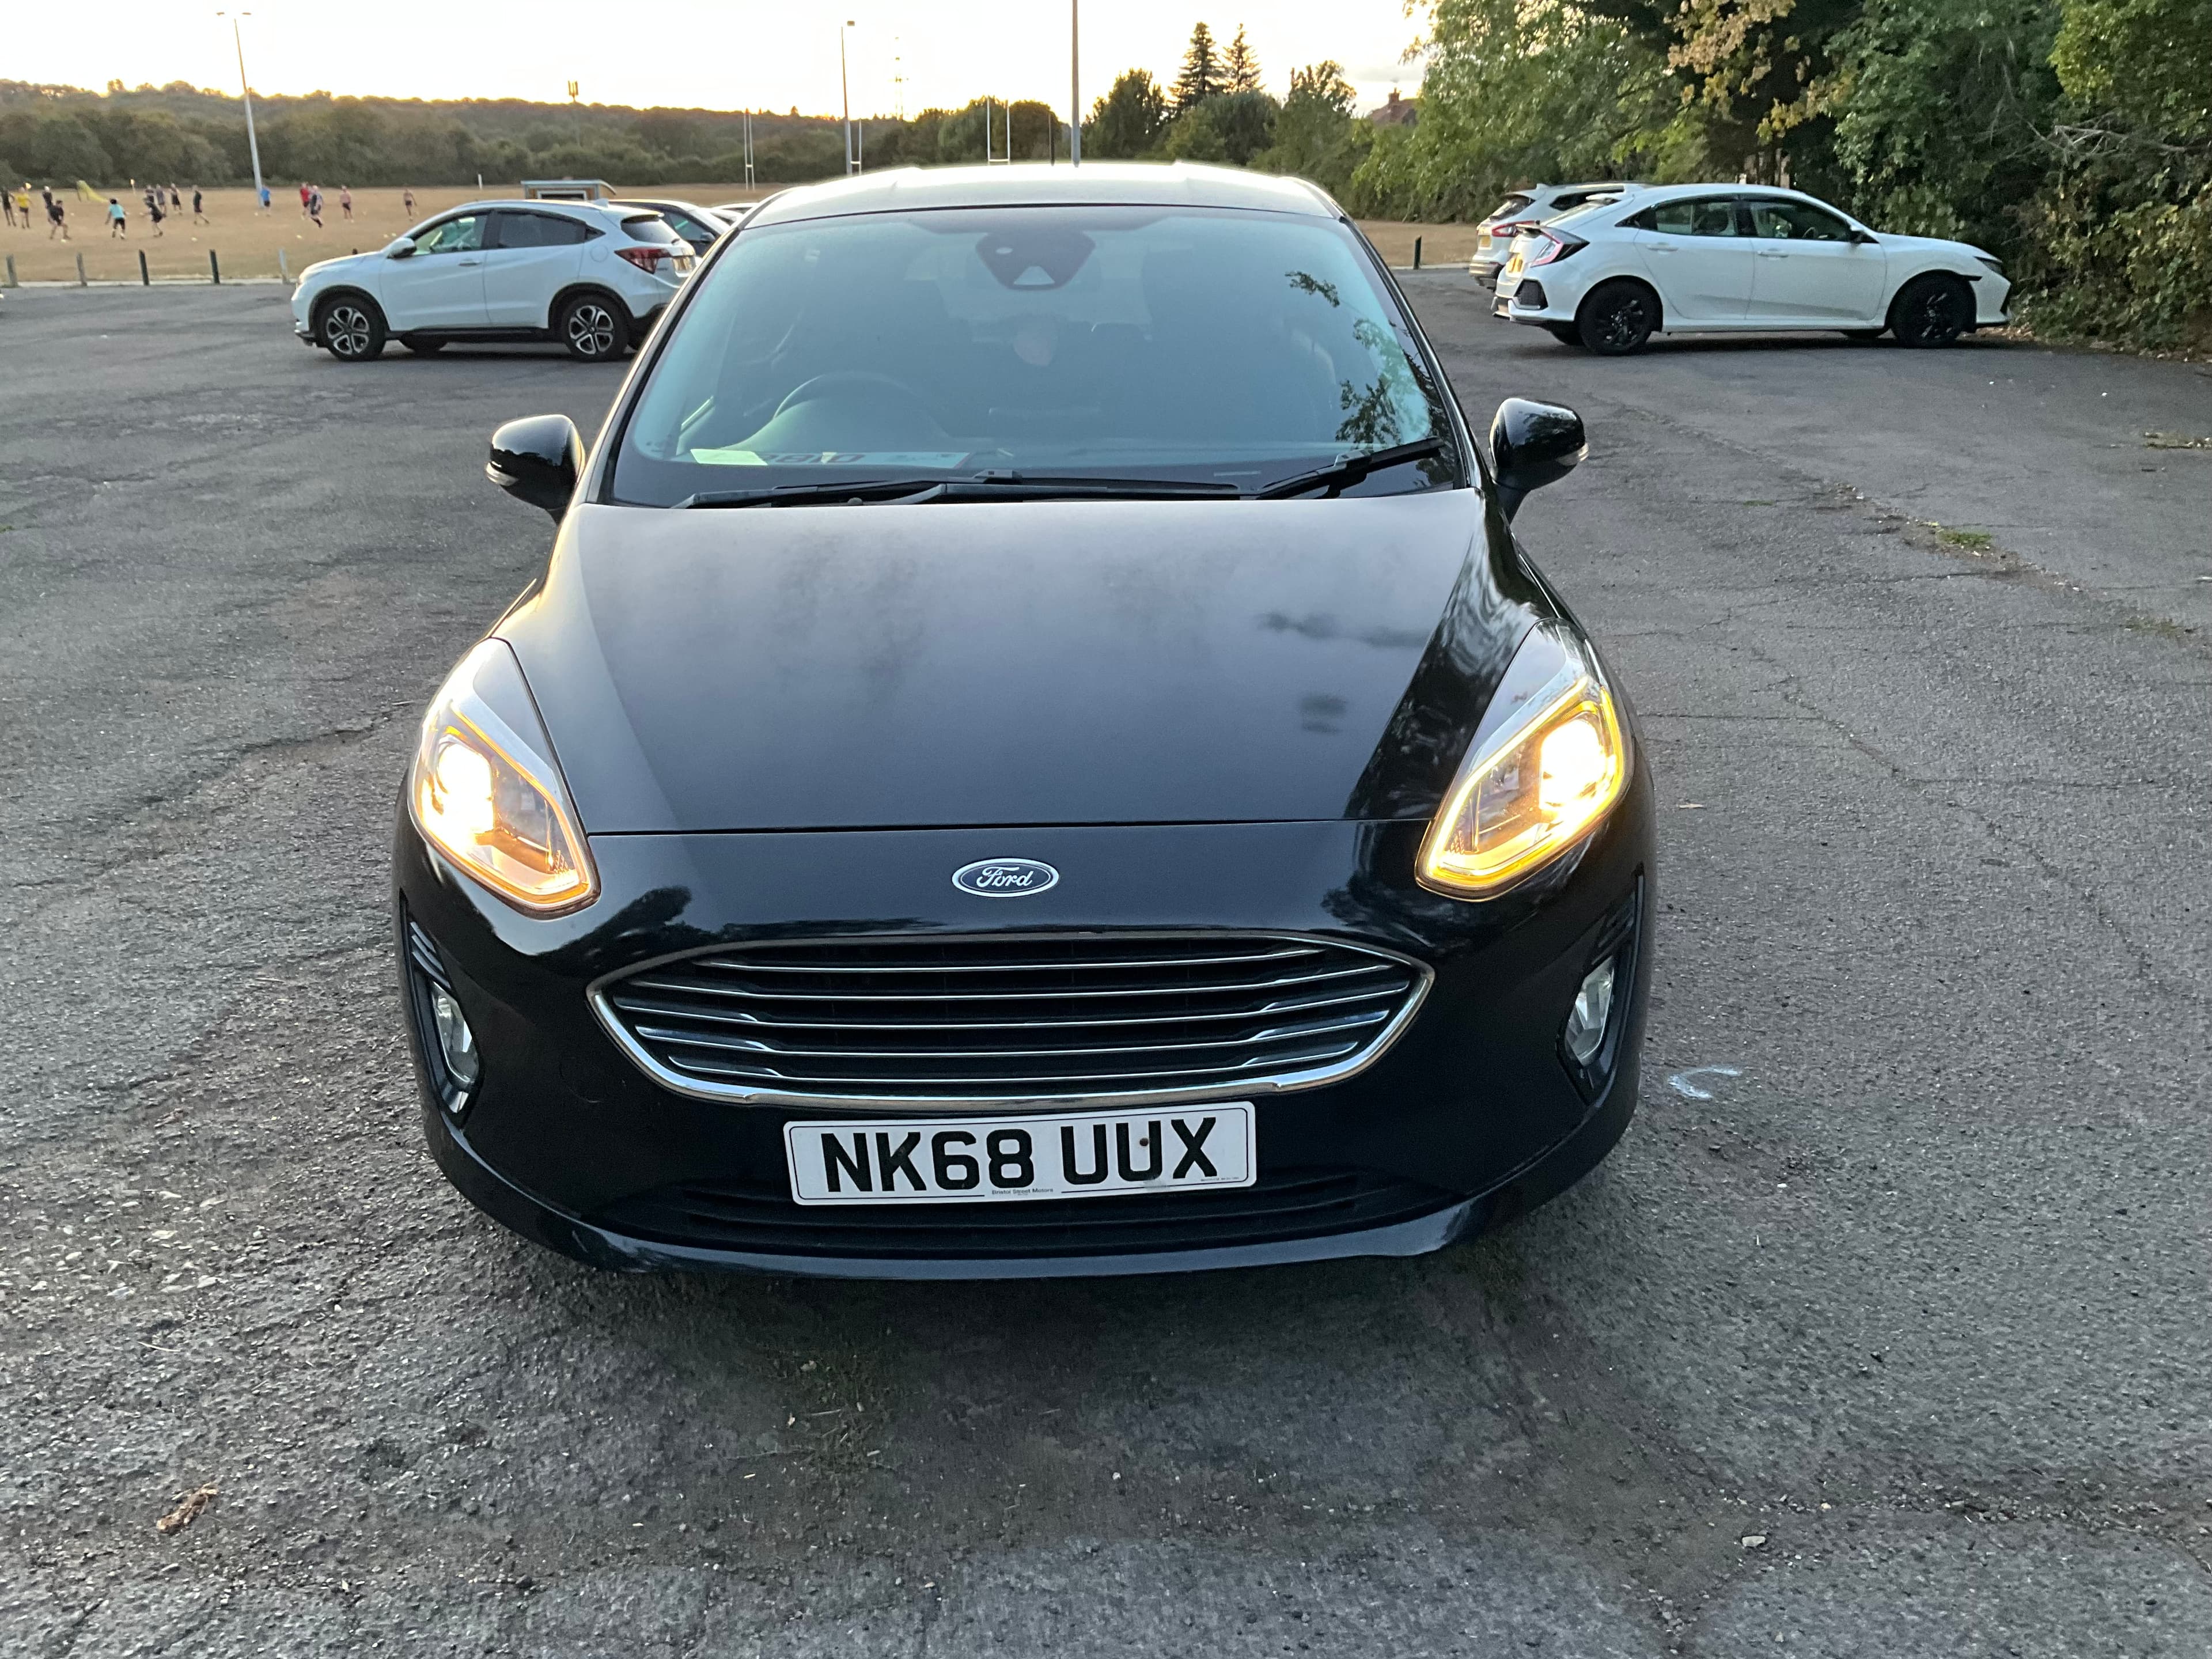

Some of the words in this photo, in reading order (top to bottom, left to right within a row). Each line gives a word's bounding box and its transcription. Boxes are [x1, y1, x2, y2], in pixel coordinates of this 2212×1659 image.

[976, 866, 1035, 888] Ford
[820, 1128, 1035, 1193] NK68
[1060, 1116, 1218, 1185] UUX
